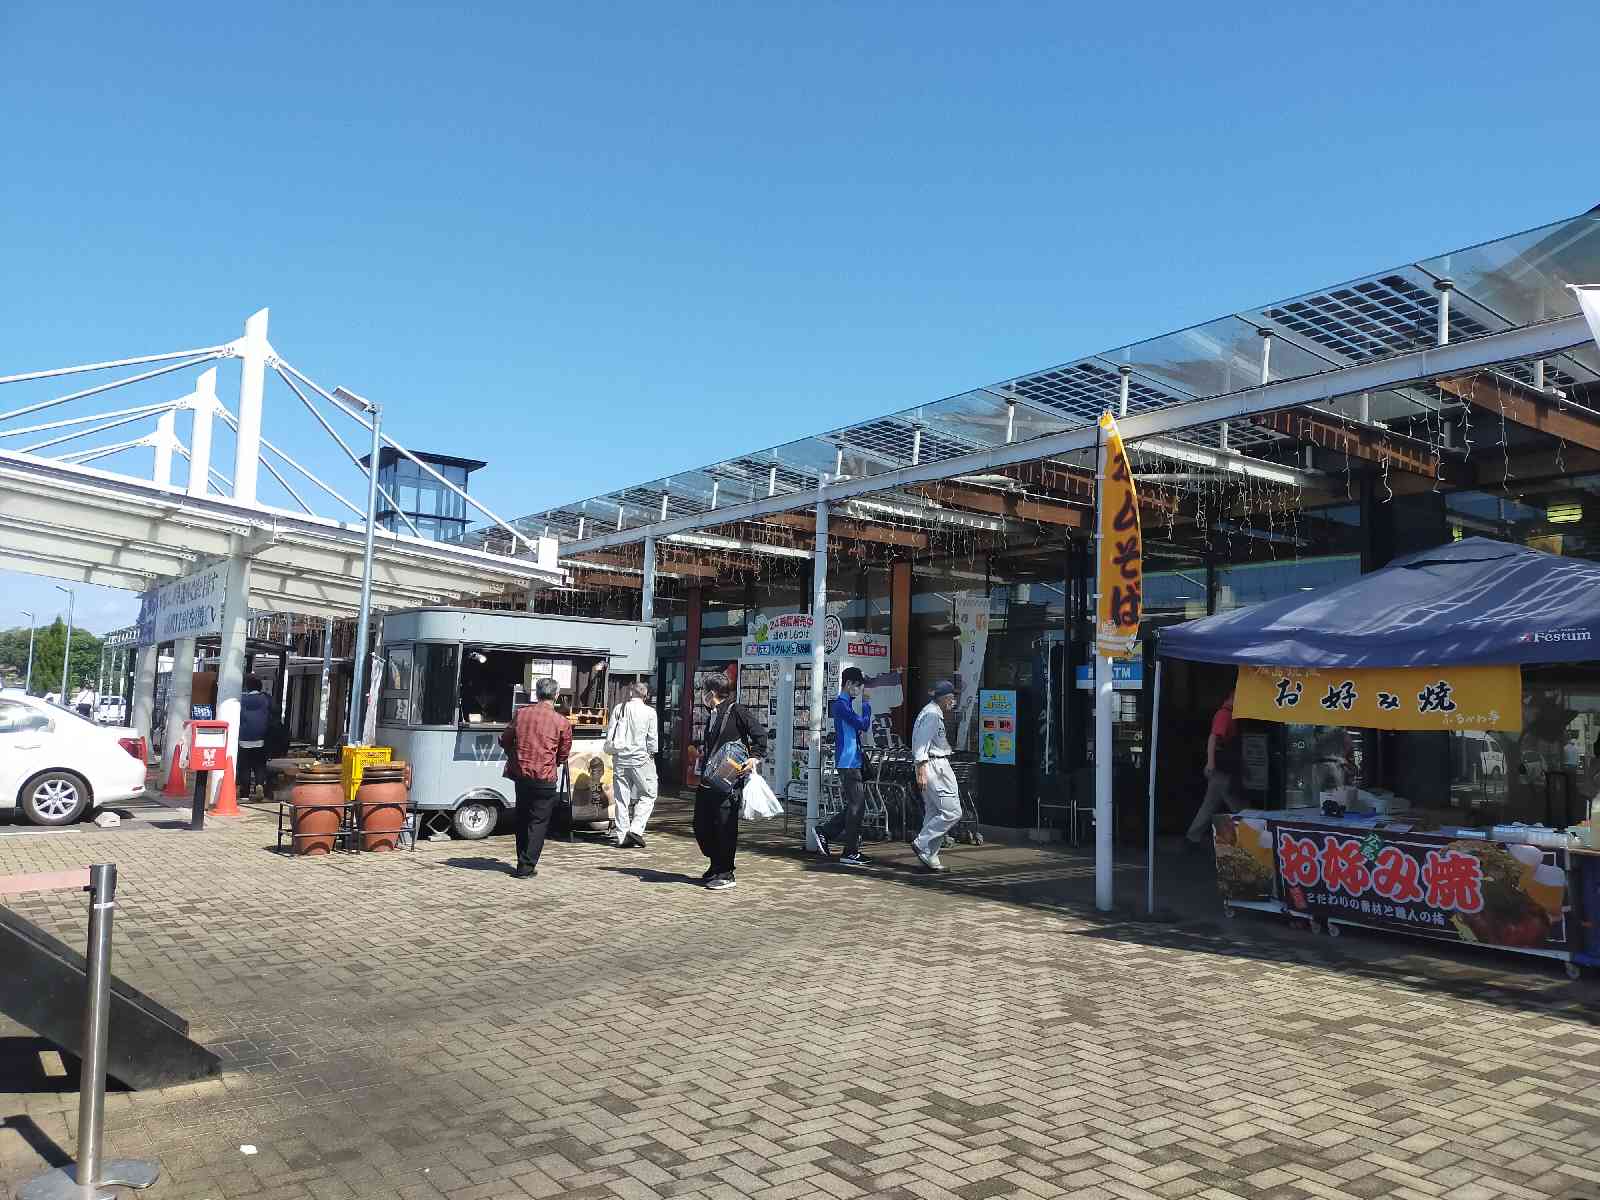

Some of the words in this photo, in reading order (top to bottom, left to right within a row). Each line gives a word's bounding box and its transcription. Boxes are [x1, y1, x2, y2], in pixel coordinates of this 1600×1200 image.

[1534, 631, 1592, 643] Festum
[1112, 667, 1131, 680] TM
[1279, 833, 1484, 914] お好み焼
